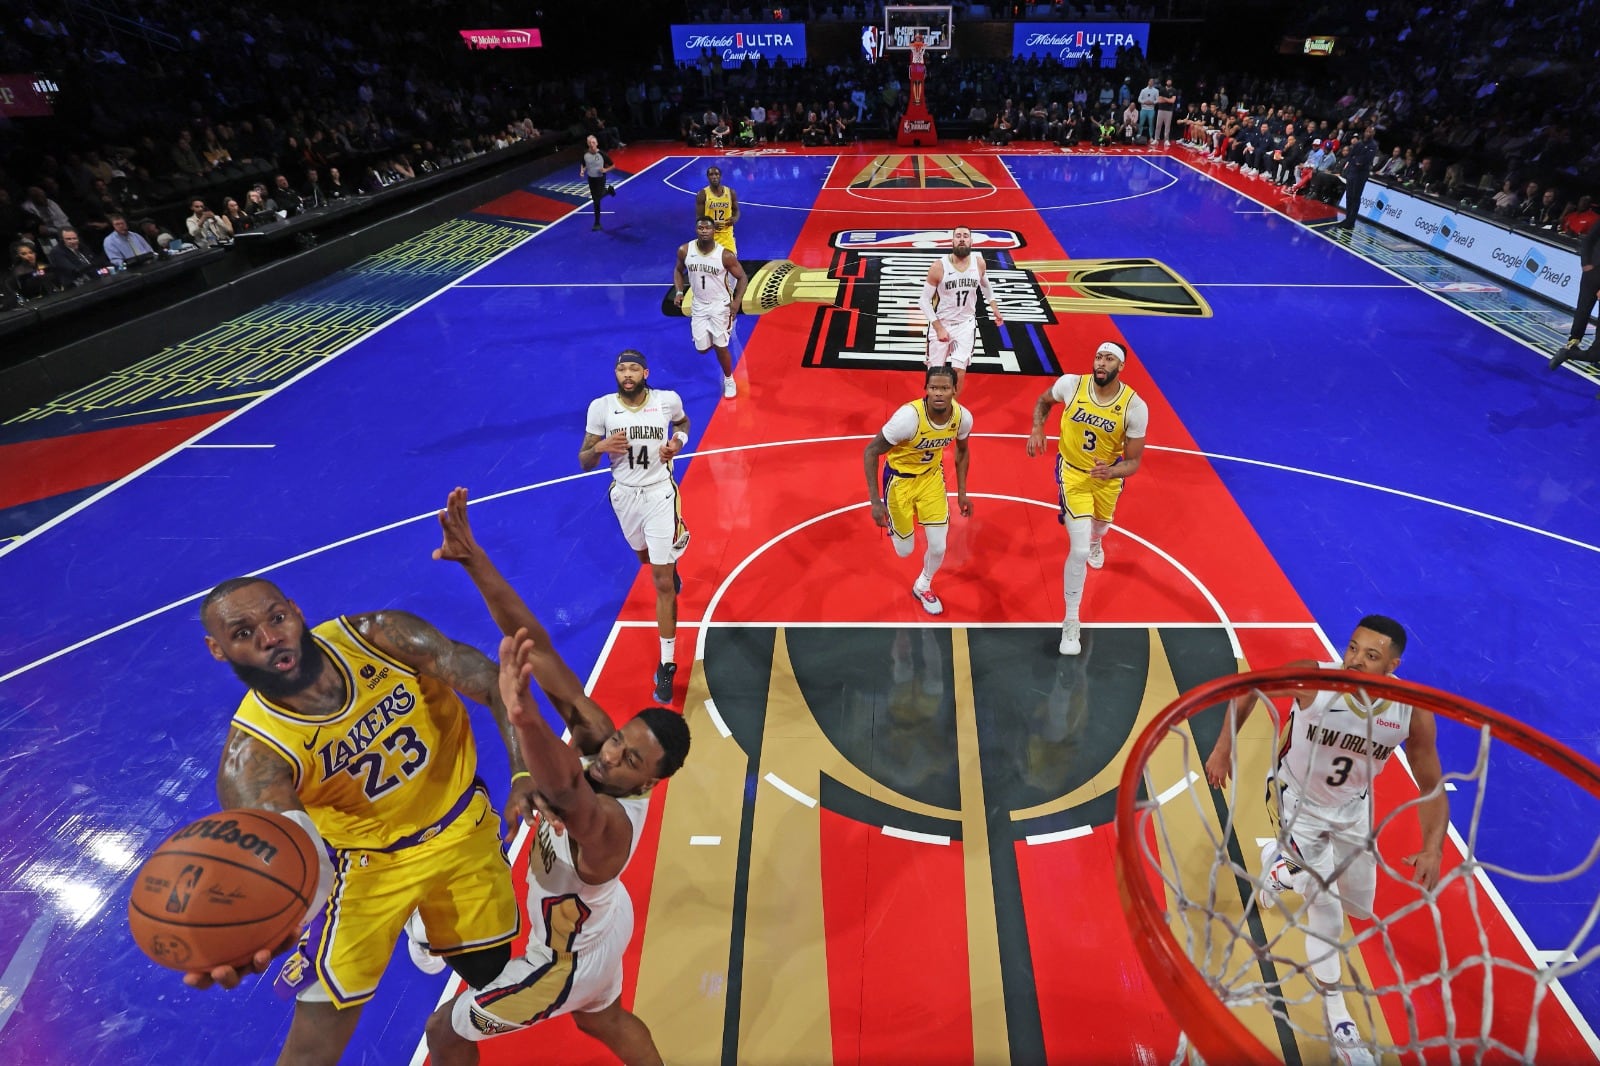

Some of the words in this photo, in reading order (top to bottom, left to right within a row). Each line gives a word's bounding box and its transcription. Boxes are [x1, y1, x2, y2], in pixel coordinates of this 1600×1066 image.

[685, 35, 734, 48] Michelob
[746, 34, 793, 46] ULTRA
[1025, 33, 1074, 46] Michelob
[1086, 33, 1135, 46] ULTRA
[709, 202, 729, 210] LAKERS
[714, 210, 725, 220] 12
[1383, 204, 1398, 217] Pixel
[1395, 209, 1402, 219] 8
[1414, 216, 1439, 235] Google
[1451, 230, 1469, 247] Pixel
[1466, 236, 1475, 248] 8
[1491, 247, 1523, 268] Google
[1539, 265, 1562, 284] Pixel
[1561, 275, 1571, 287] 8
[700, 275, 705, 290] 1
[945, 279, 957, 290] NEW
[956, 290, 970, 307] 17
[1070, 407, 1116, 433] LAKERS
[630, 425, 664, 440] ORLEANS
[1082, 430, 1098, 453] 3
[628, 445, 650, 470] 14
[367, 666, 390, 691] bibigo
[318, 683, 416, 783] LAKERS
[1376, 718, 1401, 730] ibotta
[345, 725, 430, 803] 23
[1326, 756, 1353, 787] 3
[172, 819, 278, 866] Wilson
